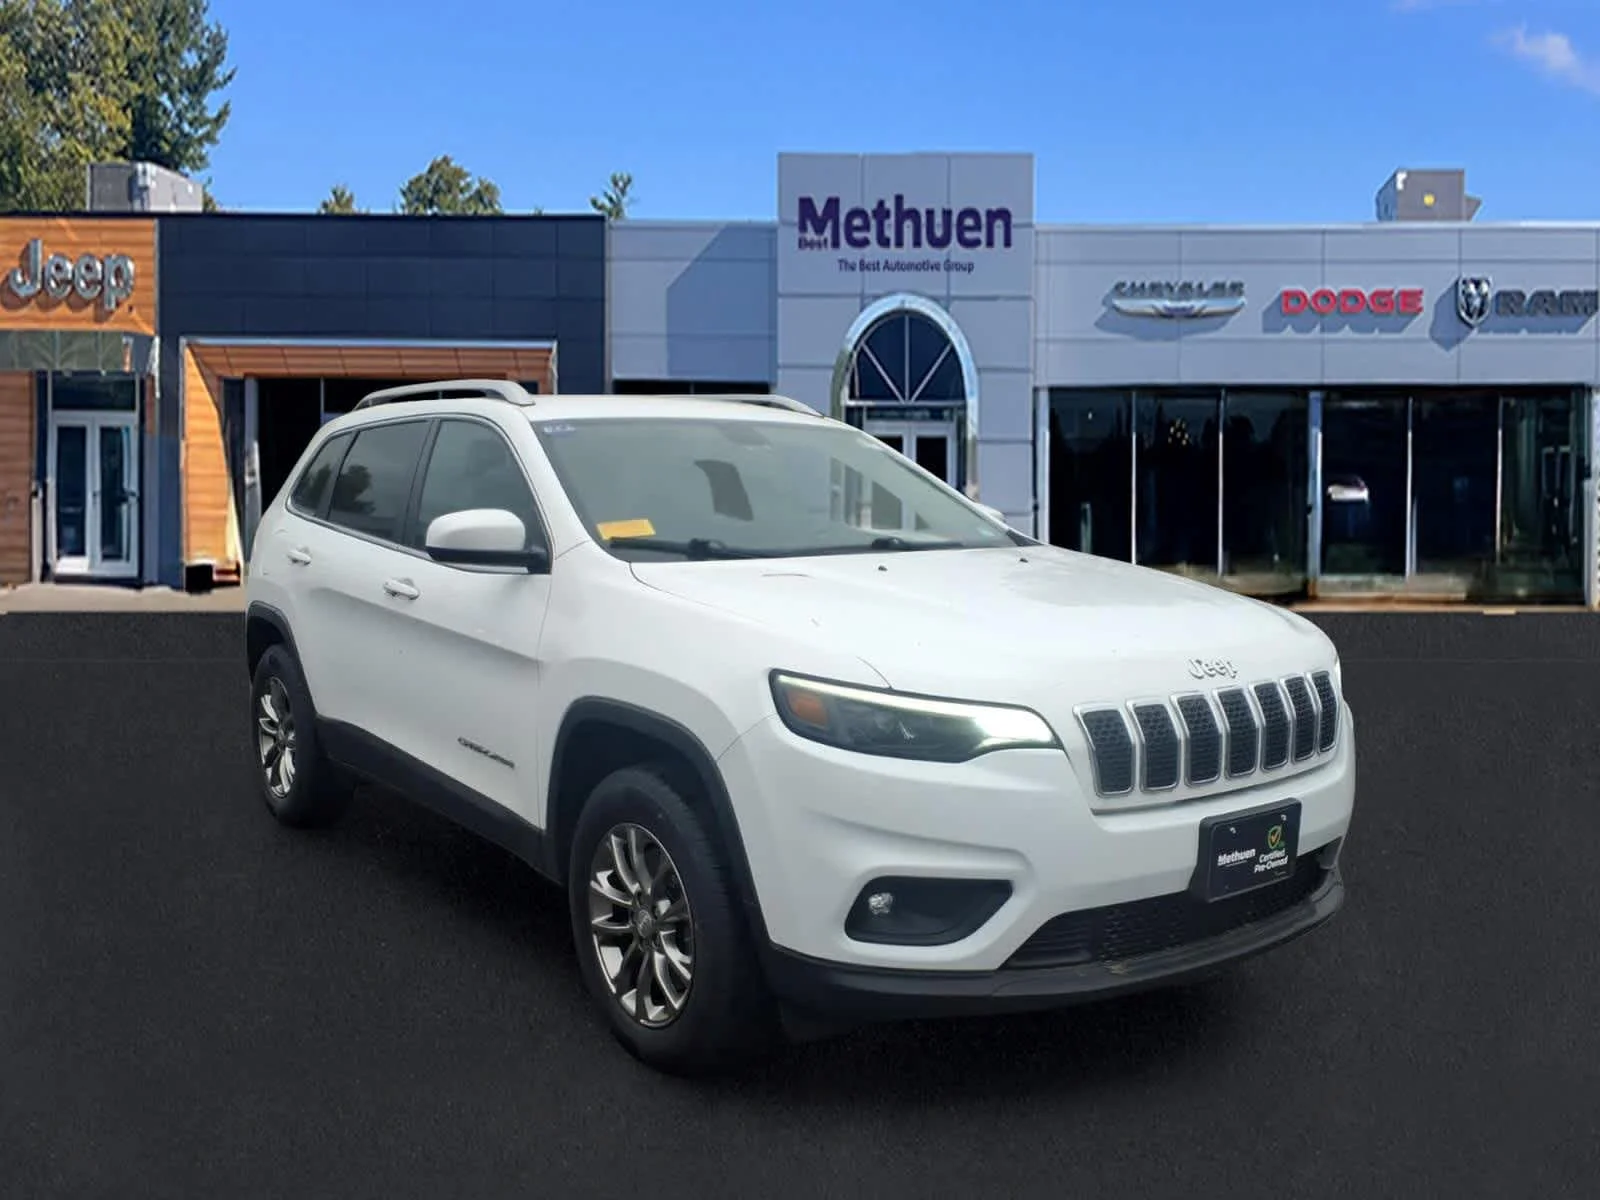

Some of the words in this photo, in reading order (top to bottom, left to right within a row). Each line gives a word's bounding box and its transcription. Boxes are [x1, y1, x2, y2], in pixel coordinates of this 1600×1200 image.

[797, 194, 1012, 249] Methuen
[9, 238, 135, 311] Jeep
[838, 259, 857, 272] The
[859, 259, 881, 272] Best
[883, 259, 941, 272] Automotive
[943, 259, 975, 274] Group
[1113, 280, 1245, 298] CHRYSLER
[1281, 289, 1424, 315] DODGE
[1495, 290, 1599, 316] RAM
[1187, 657, 1238, 680] Jeep
[1217, 848, 1256, 866] Methuen
